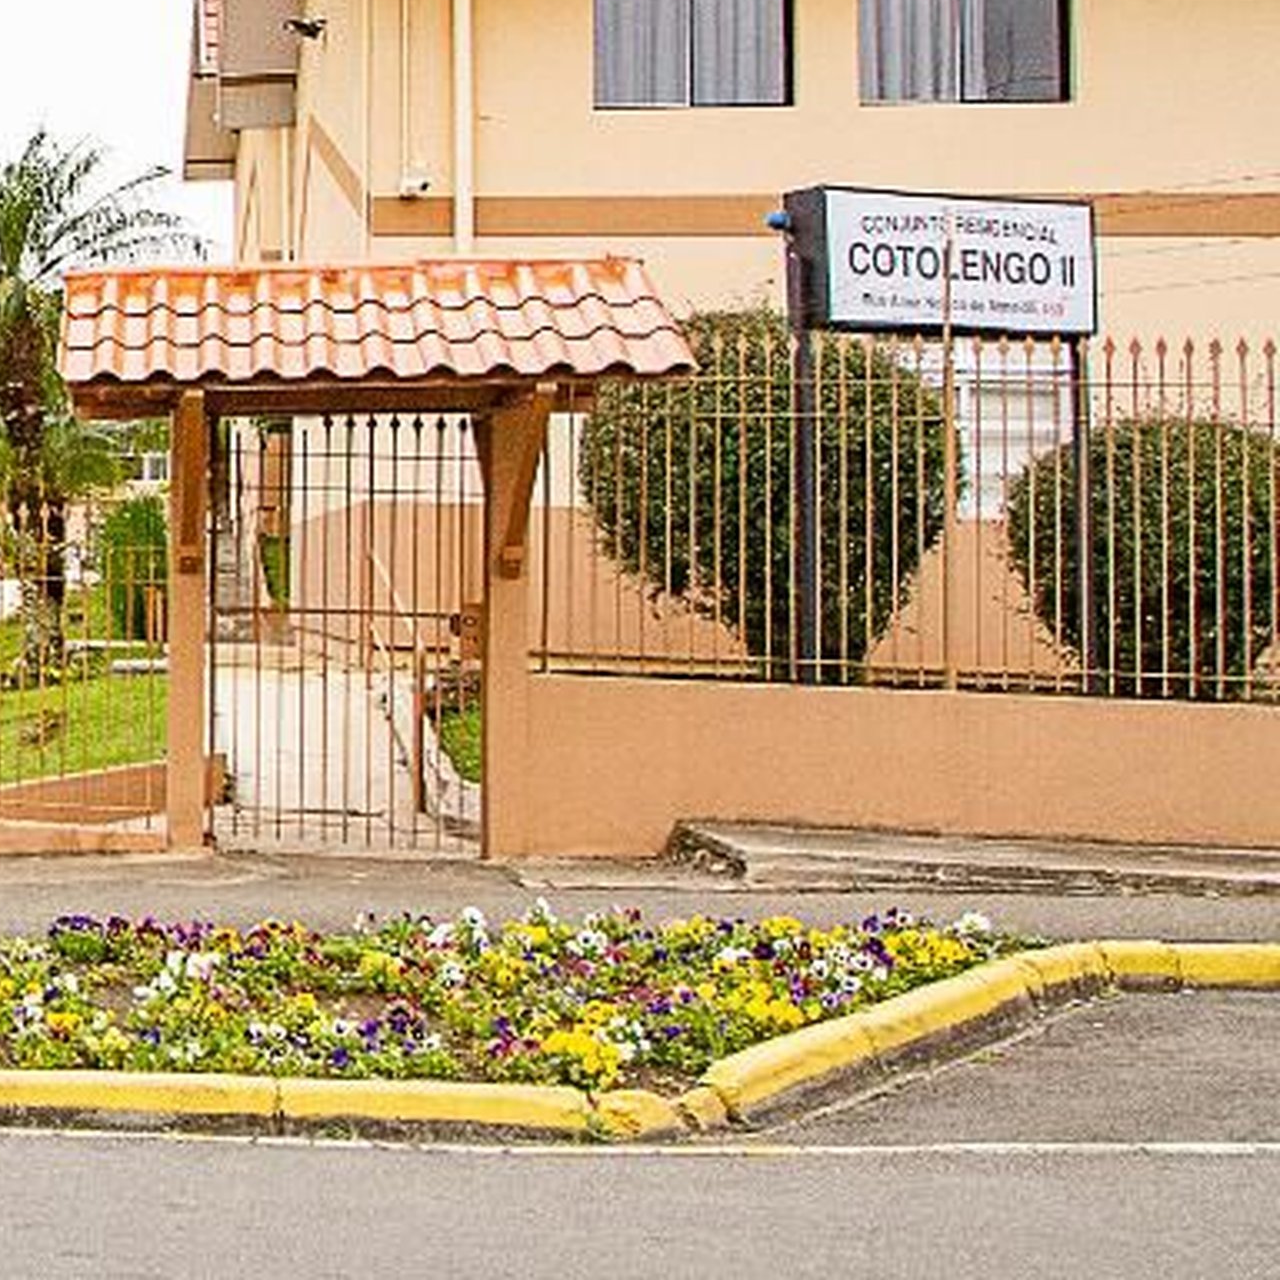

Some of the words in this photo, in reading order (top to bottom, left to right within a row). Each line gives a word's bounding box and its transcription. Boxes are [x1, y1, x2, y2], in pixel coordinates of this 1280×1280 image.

[955, 216, 1058, 244] RESIDENCIAL
[848, 242, 1051, 285] COTOLENGO
[1061, 255, 1075, 287] II
